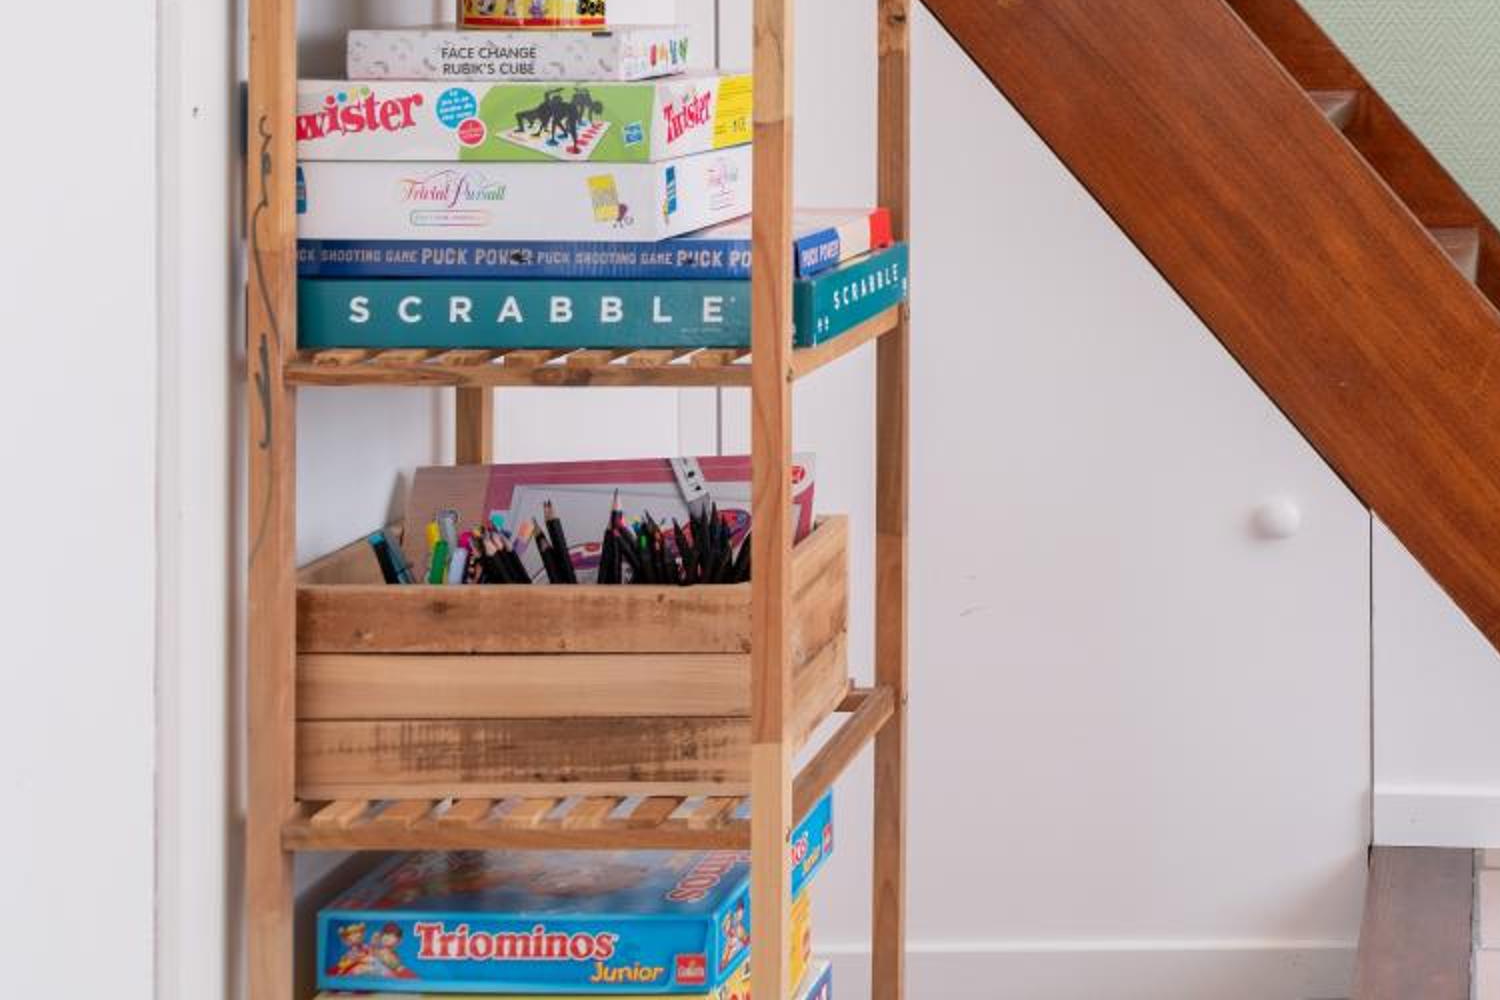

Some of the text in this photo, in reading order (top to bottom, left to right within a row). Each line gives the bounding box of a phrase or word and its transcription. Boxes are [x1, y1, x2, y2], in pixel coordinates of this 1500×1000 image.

[441, 47, 537, 59] FACE CHANGE
[442, 63, 536, 75] RUBIK'S CUBE
[296, 91, 425, 141] wister
[663, 90, 711, 143] Twister
[319, 249, 381, 263] SHOOTING
[385, 249, 417, 263] GAME
[420, 248, 467, 265] PUCK
[536, 251, 570, 265] PUCK
[575, 251, 636, 265] SHOOTING
[640, 251, 673, 265] GAME
[833, 262, 898, 311] SCRABBLE
[348, 295, 725, 324] SCRABBLE
[414, 922, 619, 961] Triominos
[589, 962, 664, 984] Junior
